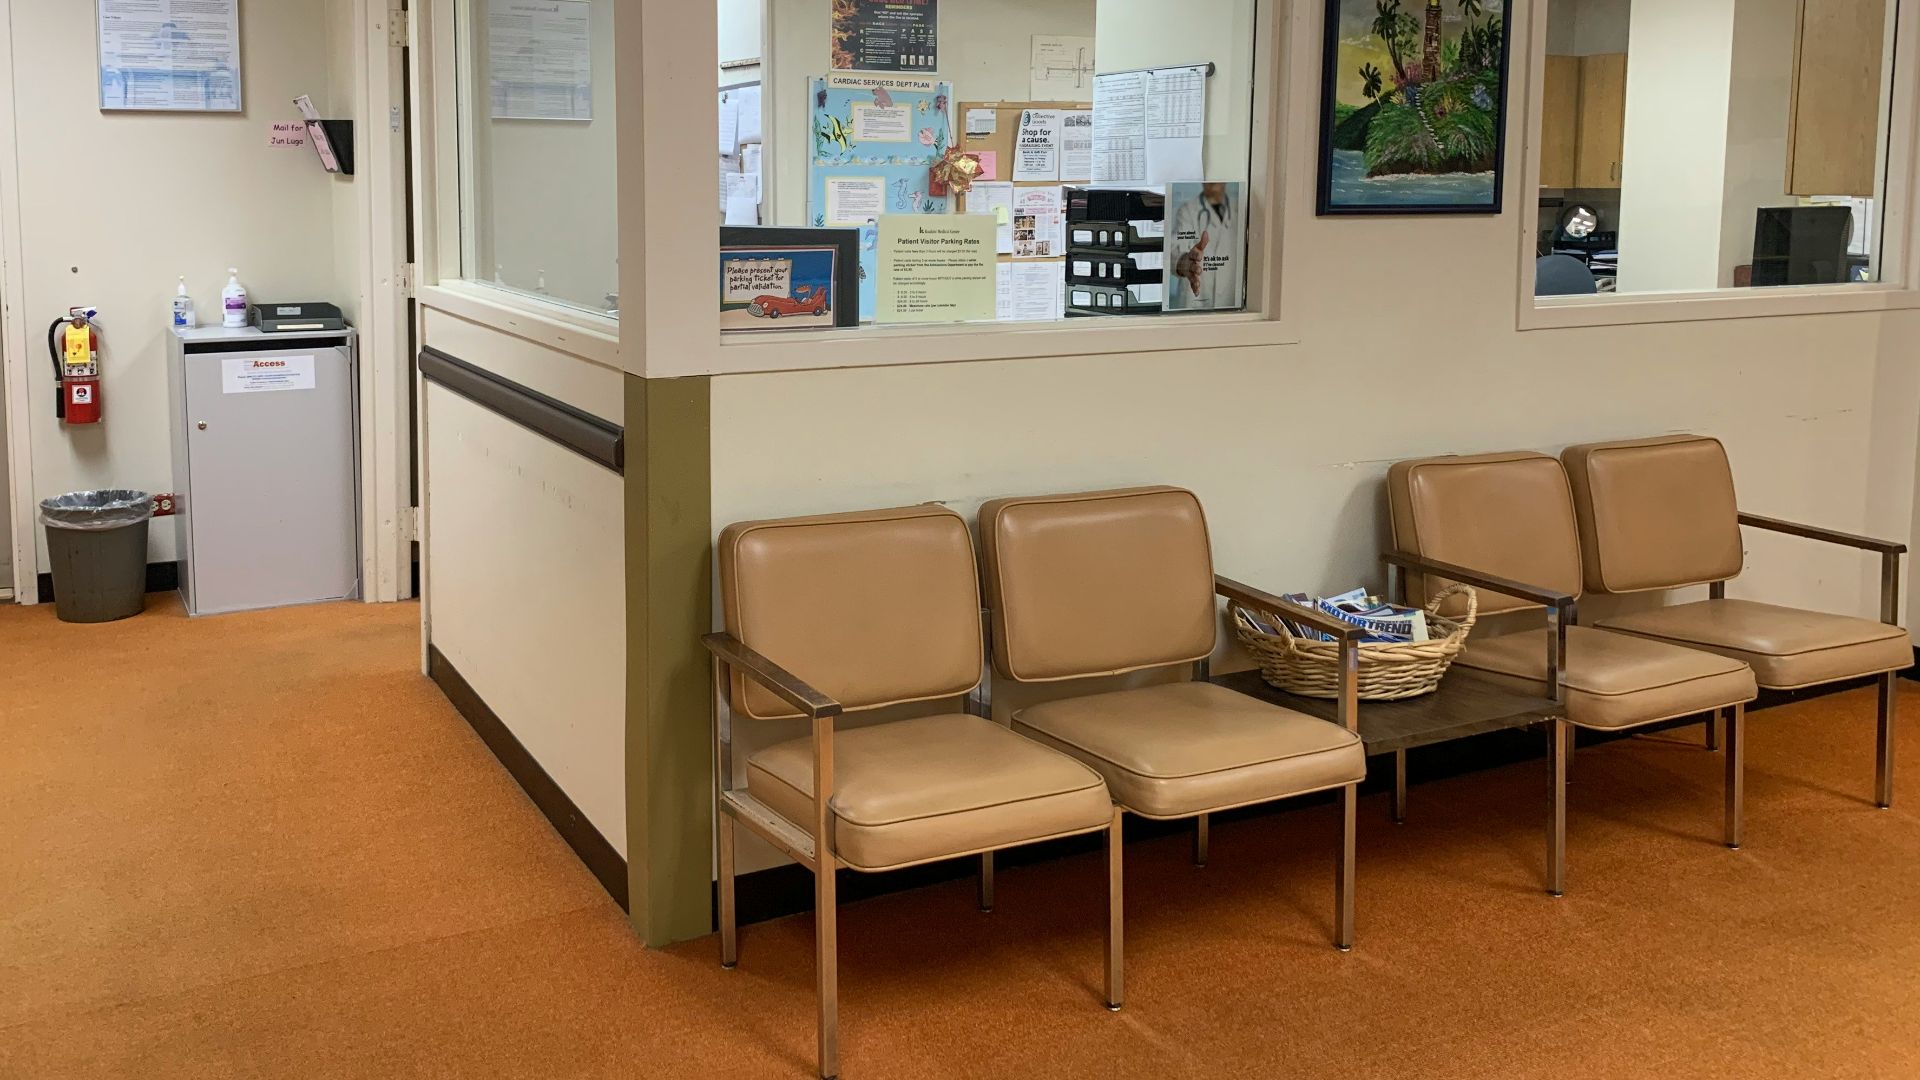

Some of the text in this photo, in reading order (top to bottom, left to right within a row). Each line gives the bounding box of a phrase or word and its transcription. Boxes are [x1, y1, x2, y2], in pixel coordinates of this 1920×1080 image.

[833, 78, 862, 86] CARDIAC
[1022, 128, 1038, 137] Shop
[750, 267, 773, 276] present
[775, 268, 788, 276] your
[730, 275, 752, 284] parking
[730, 282, 783, 293] partial validation.
